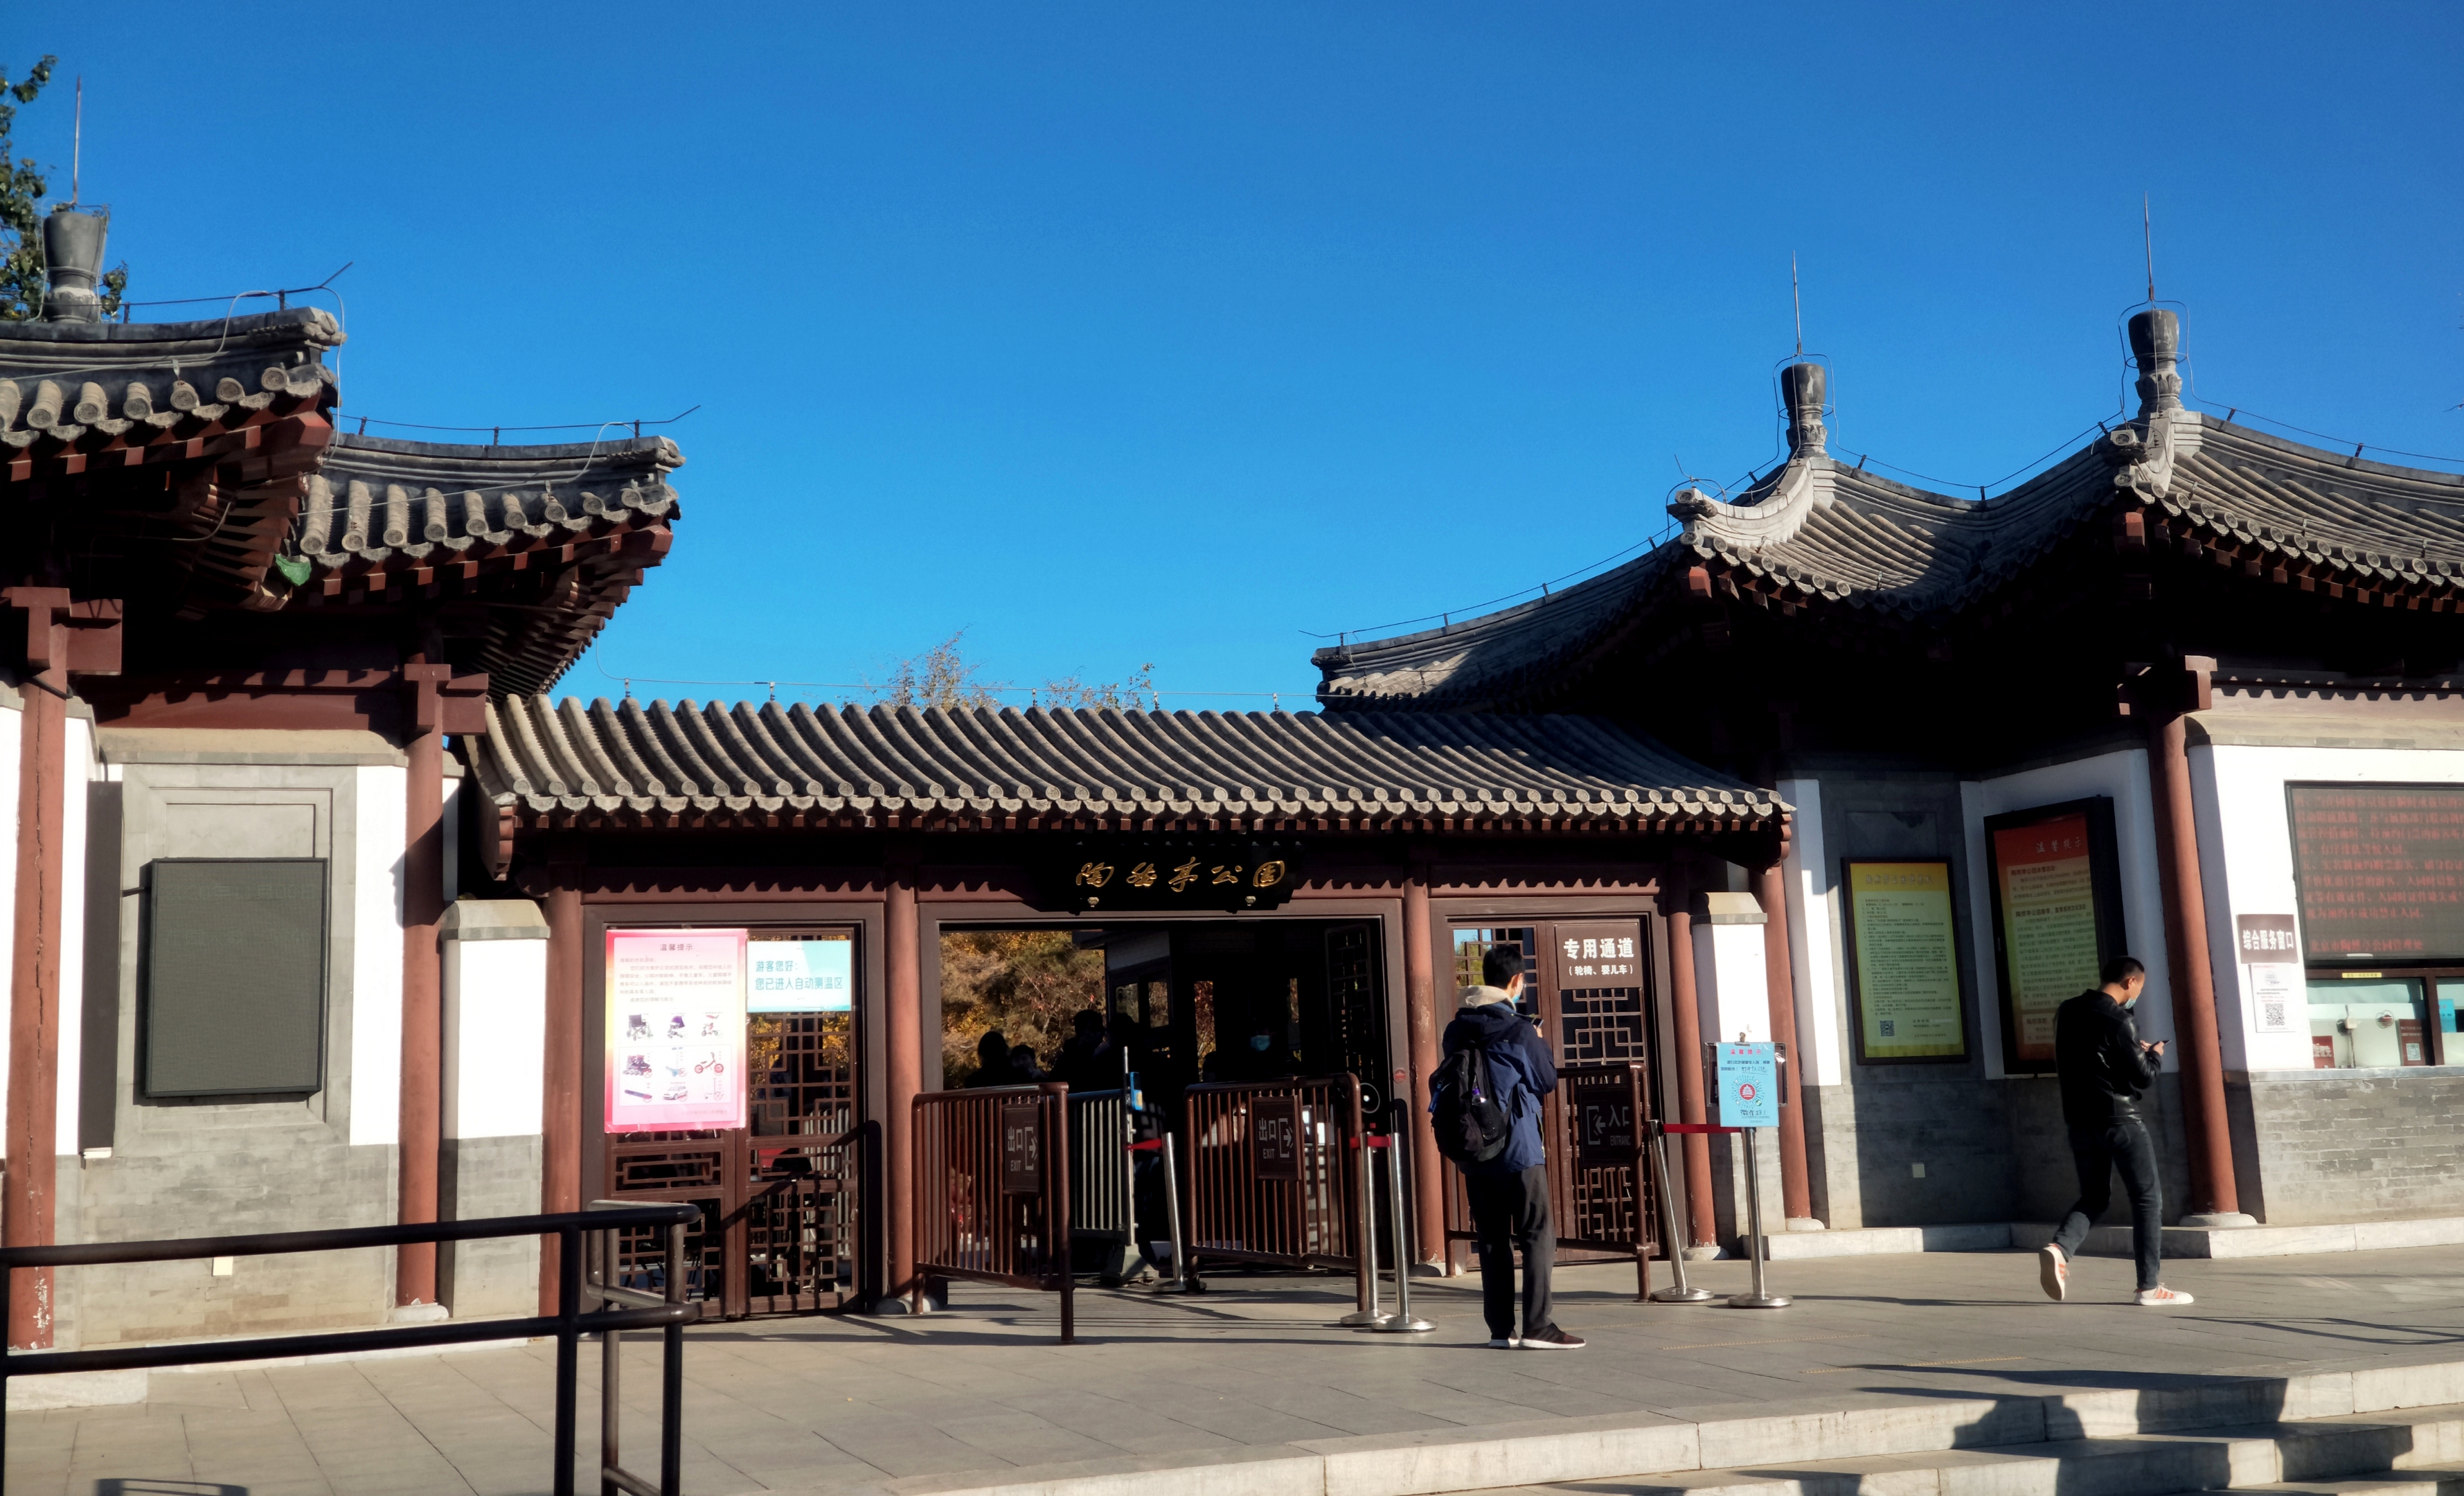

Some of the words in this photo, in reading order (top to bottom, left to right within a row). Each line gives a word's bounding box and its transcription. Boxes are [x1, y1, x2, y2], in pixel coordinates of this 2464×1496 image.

[1075, 856, 1285, 892] 陶然亭公园
[2242, 929, 2294, 950] 综合服务窗口
[1563, 937, 1634, 960] 专用通道
[756, 960, 798, 972] 游客您好：
[755, 977, 843, 990] 您已进入自动测温区
[1258, 1117, 1276, 1141] 出口
[1008, 1125, 1023, 1152] 出口
[1610, 1135, 1631, 1146] ENTRANC
[1263, 1148, 1275, 1159] EXIT
[1010, 1159, 1021, 1171] EXIT
